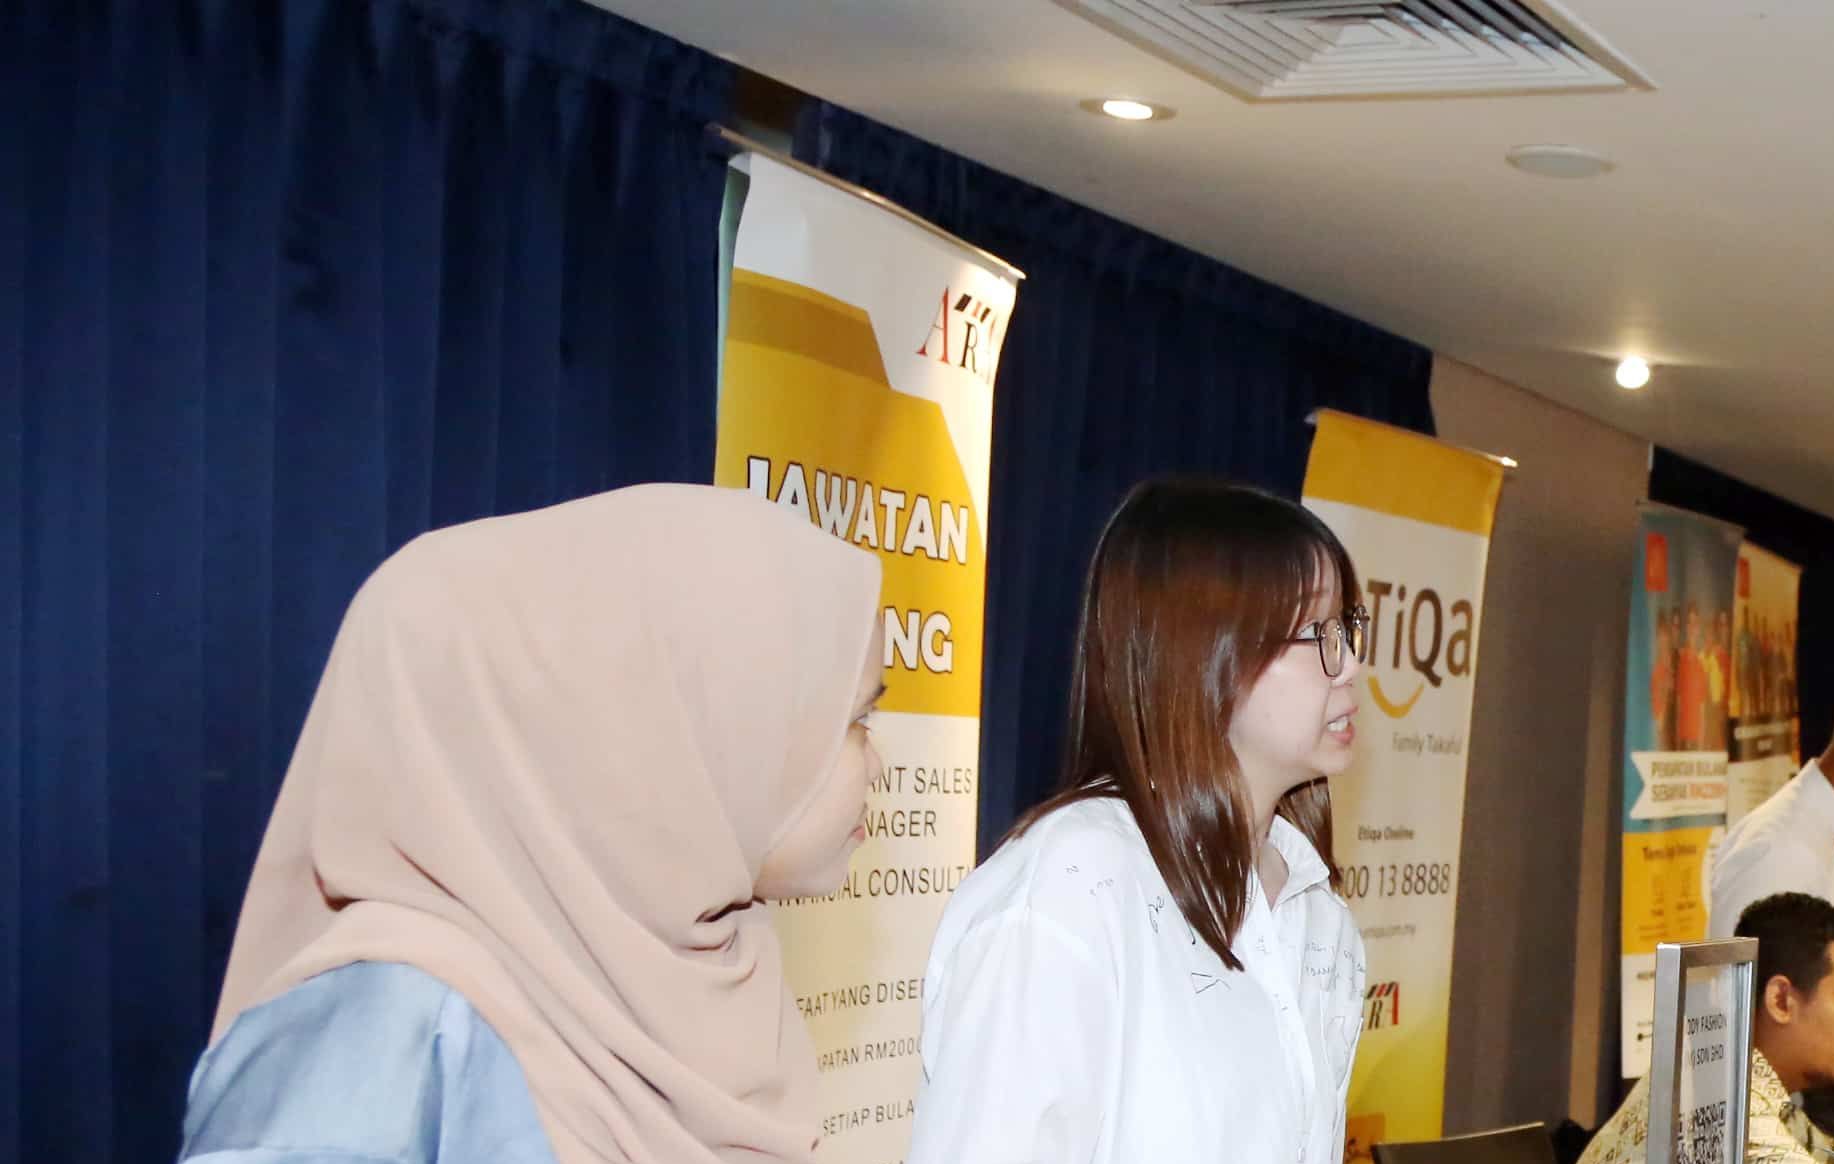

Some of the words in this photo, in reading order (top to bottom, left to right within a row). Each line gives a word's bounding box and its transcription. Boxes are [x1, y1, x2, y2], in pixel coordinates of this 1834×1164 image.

[883, 606, 953, 676] NG
[914, 767, 973, 794] SALES
[868, 865, 971, 897] CONSULT
